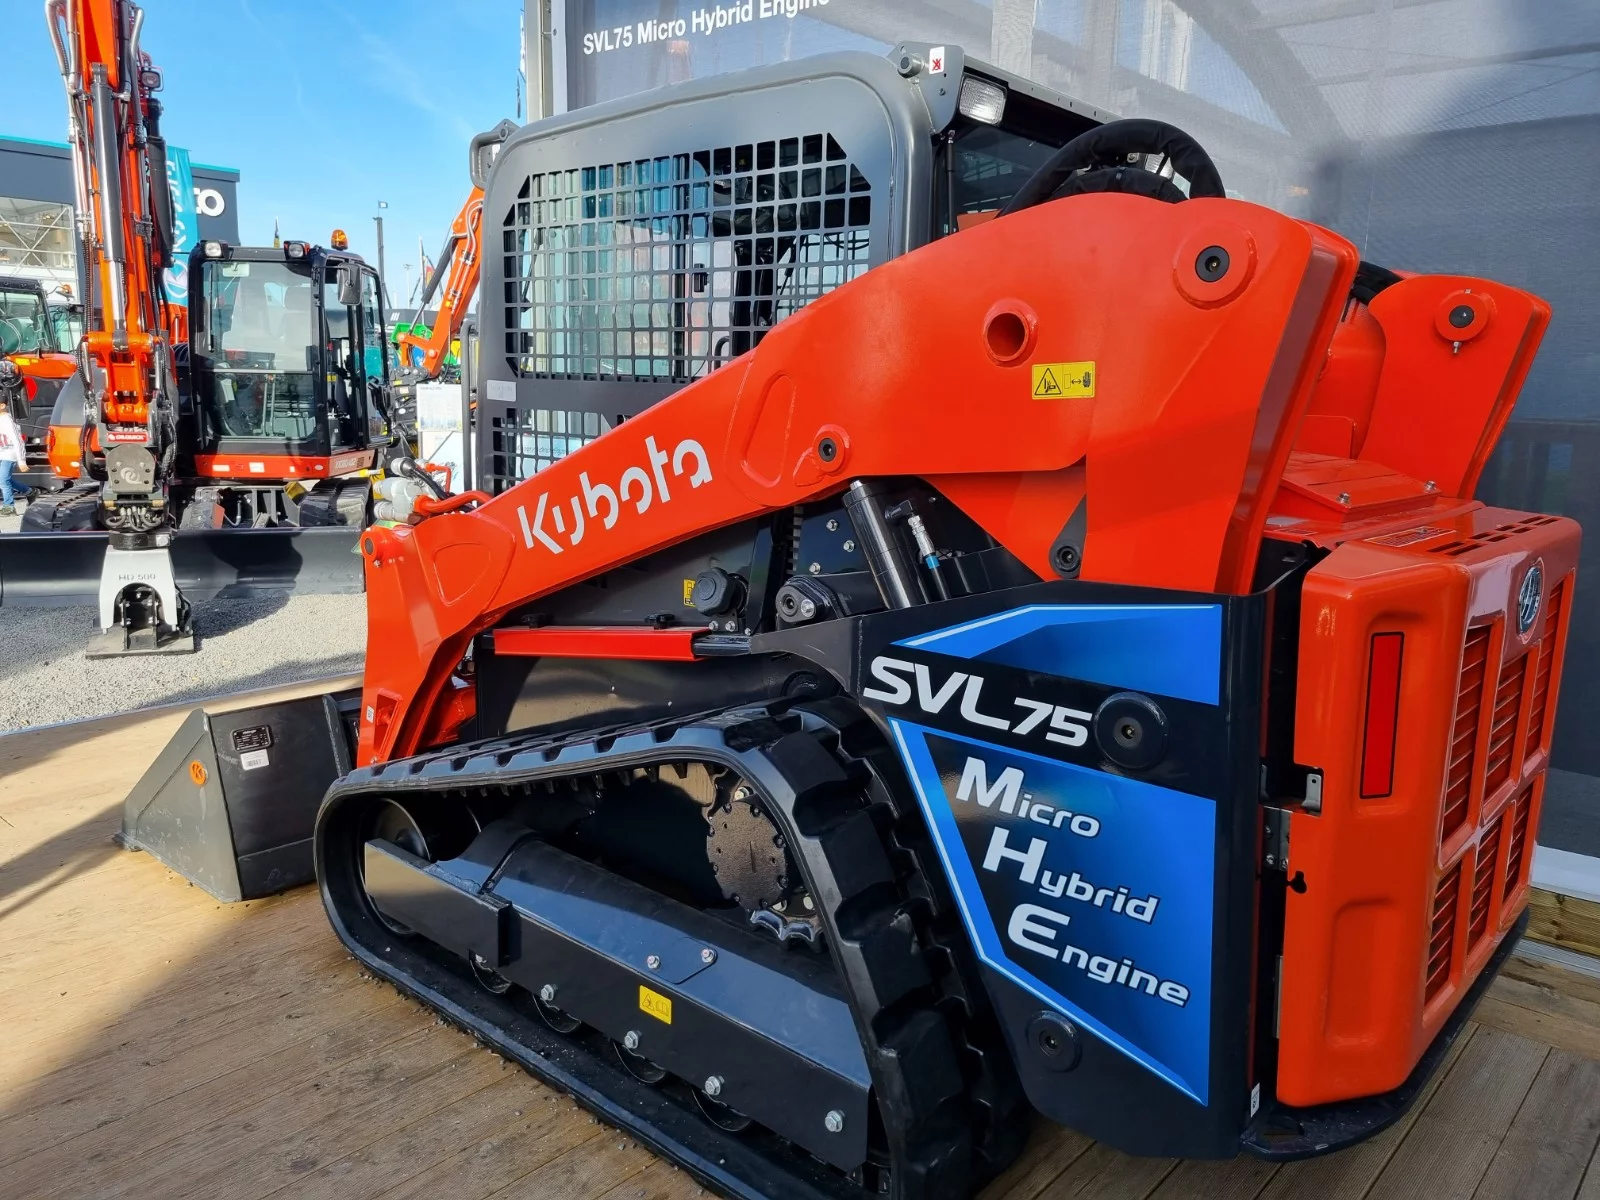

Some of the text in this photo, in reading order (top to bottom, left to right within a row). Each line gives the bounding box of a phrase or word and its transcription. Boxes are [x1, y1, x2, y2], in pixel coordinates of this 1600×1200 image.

[583, 25, 633, 55] SVL75
[637, 17, 686, 45] Micro
[691, 0, 753, 35] Hybrid
[517, 435, 713, 555] Kubota
[955, 756, 1100, 838] Micro
[982, 826, 1159, 924] Hybrid
[1007, 903, 1191, 1007] Engine
